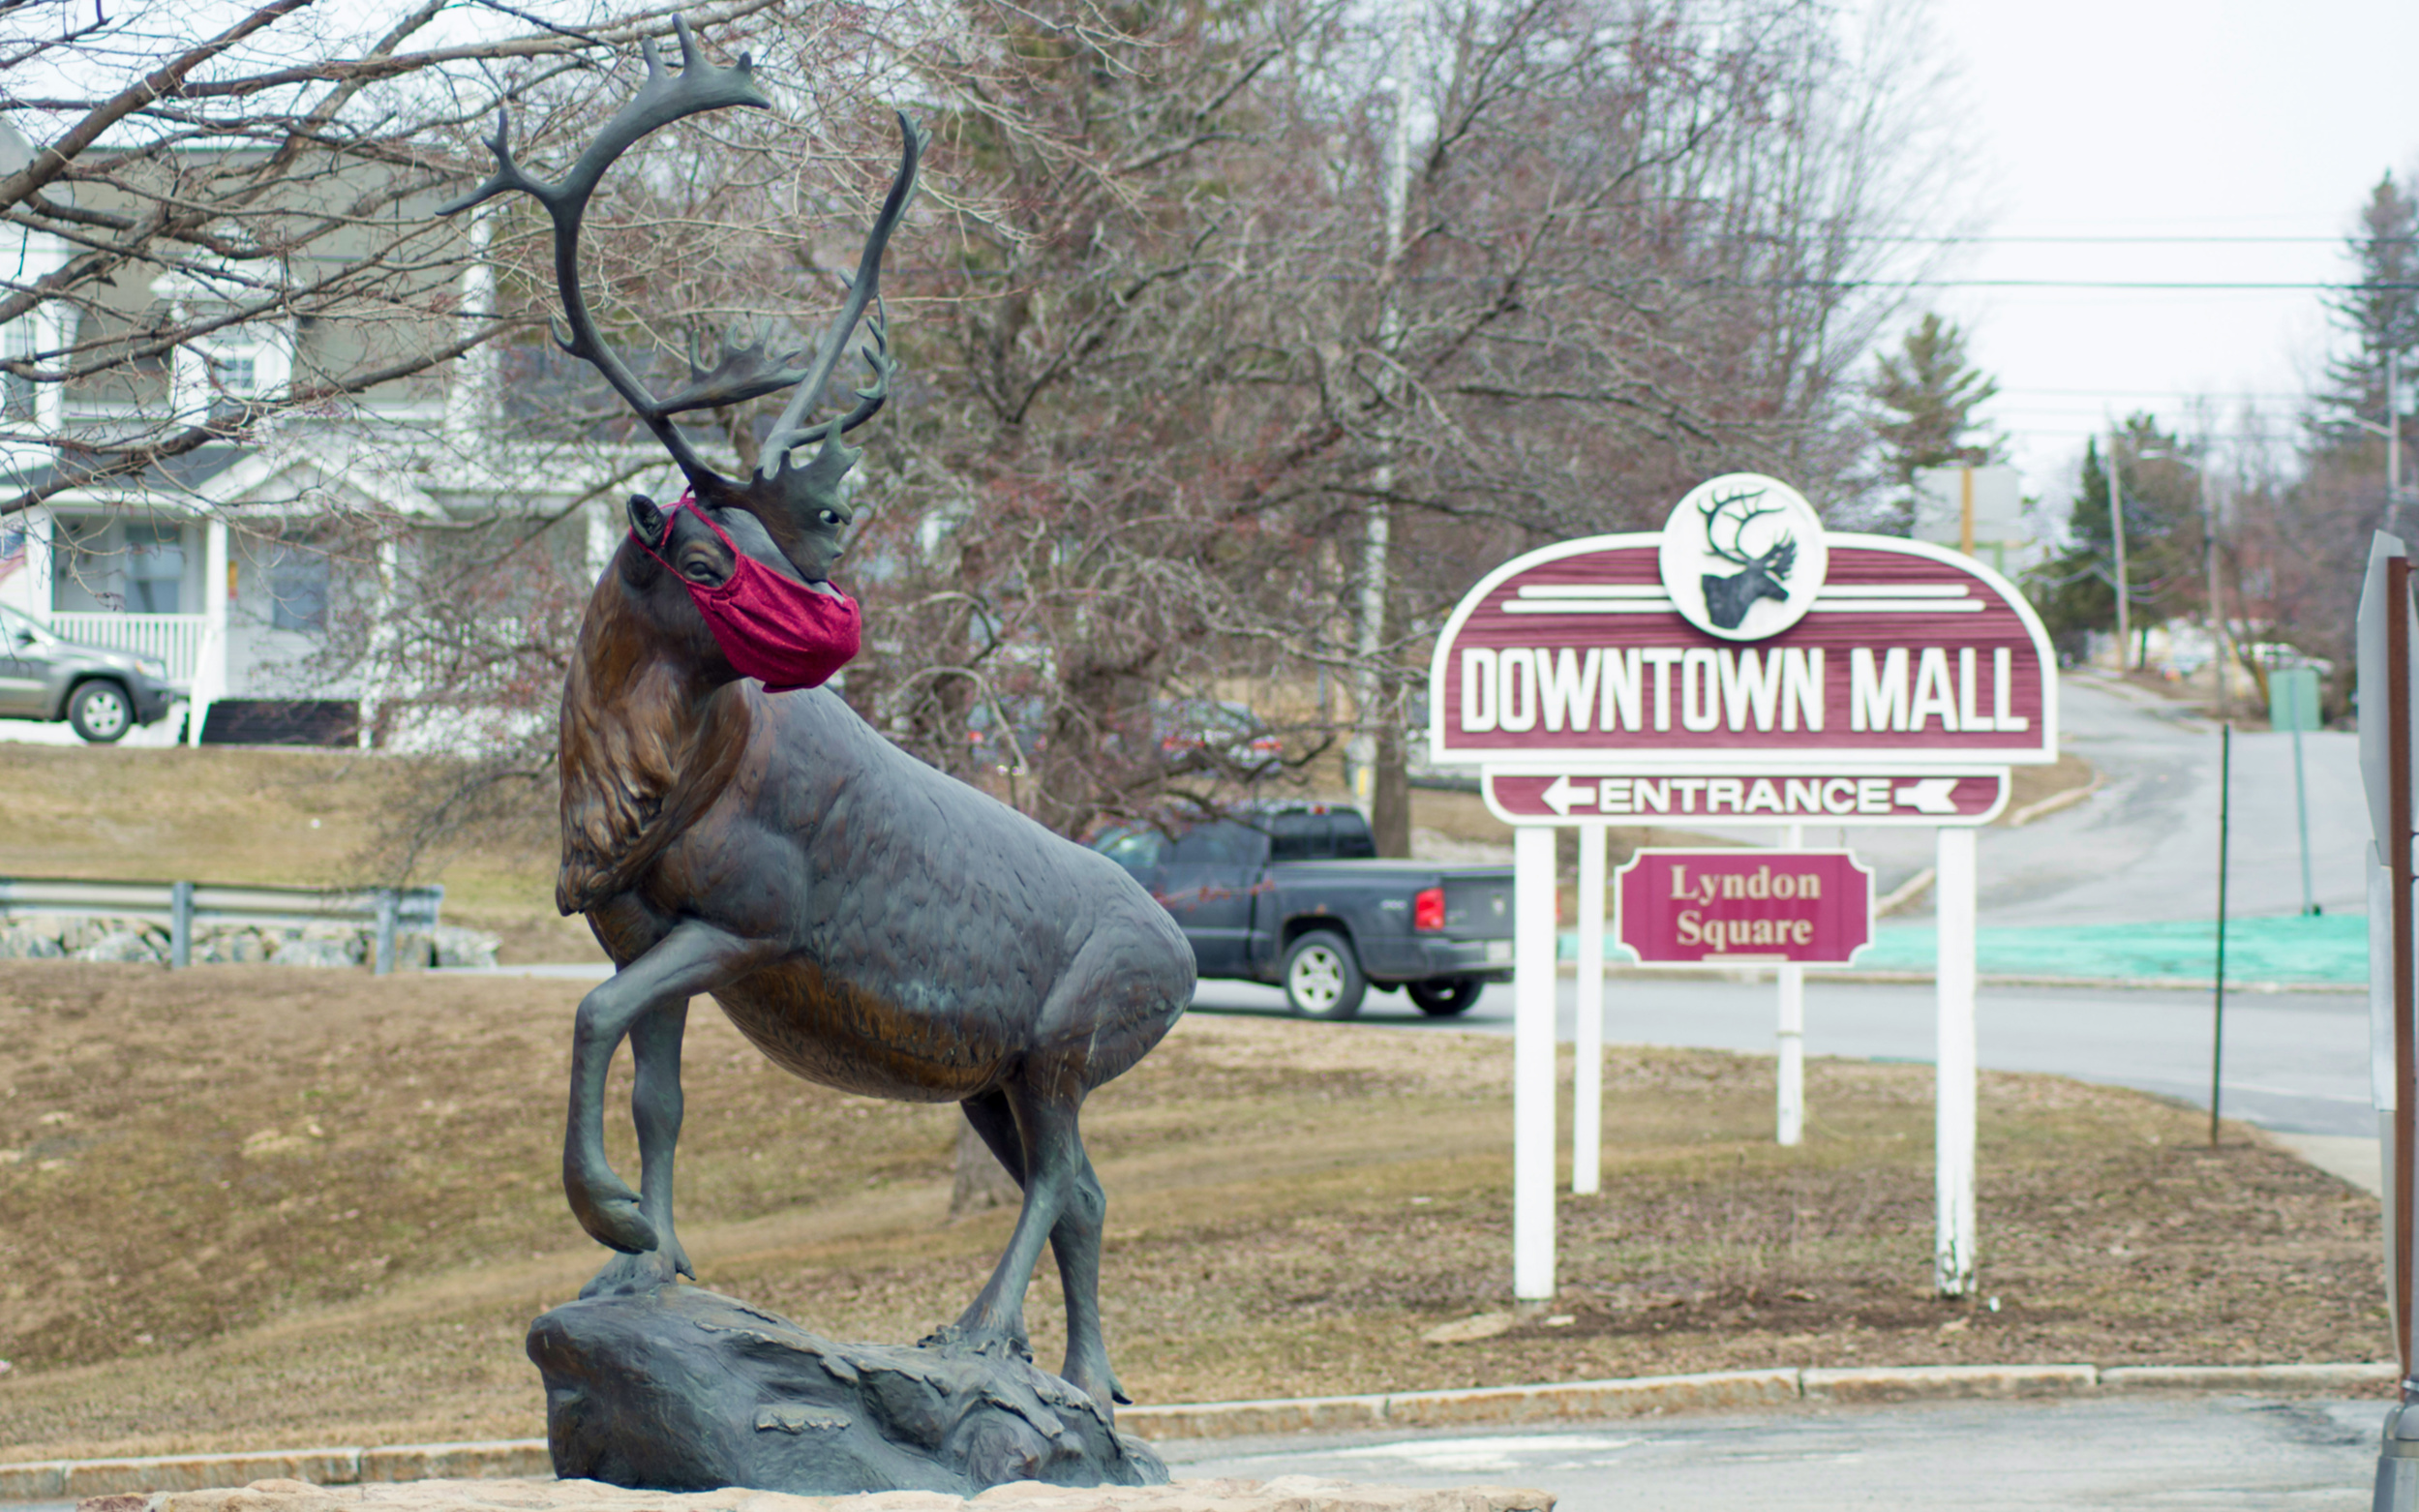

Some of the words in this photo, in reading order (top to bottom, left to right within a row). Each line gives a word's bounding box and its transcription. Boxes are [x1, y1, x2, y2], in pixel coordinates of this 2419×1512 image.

[1461, 647, 1825, 733] DOWNTOWN
[1850, 647, 2030, 733] MALL
[1598, 777, 1892, 814] ENTRANCE
[1670, 864, 1821, 907] Lyndon
[1676, 909, 1814, 953] Square
